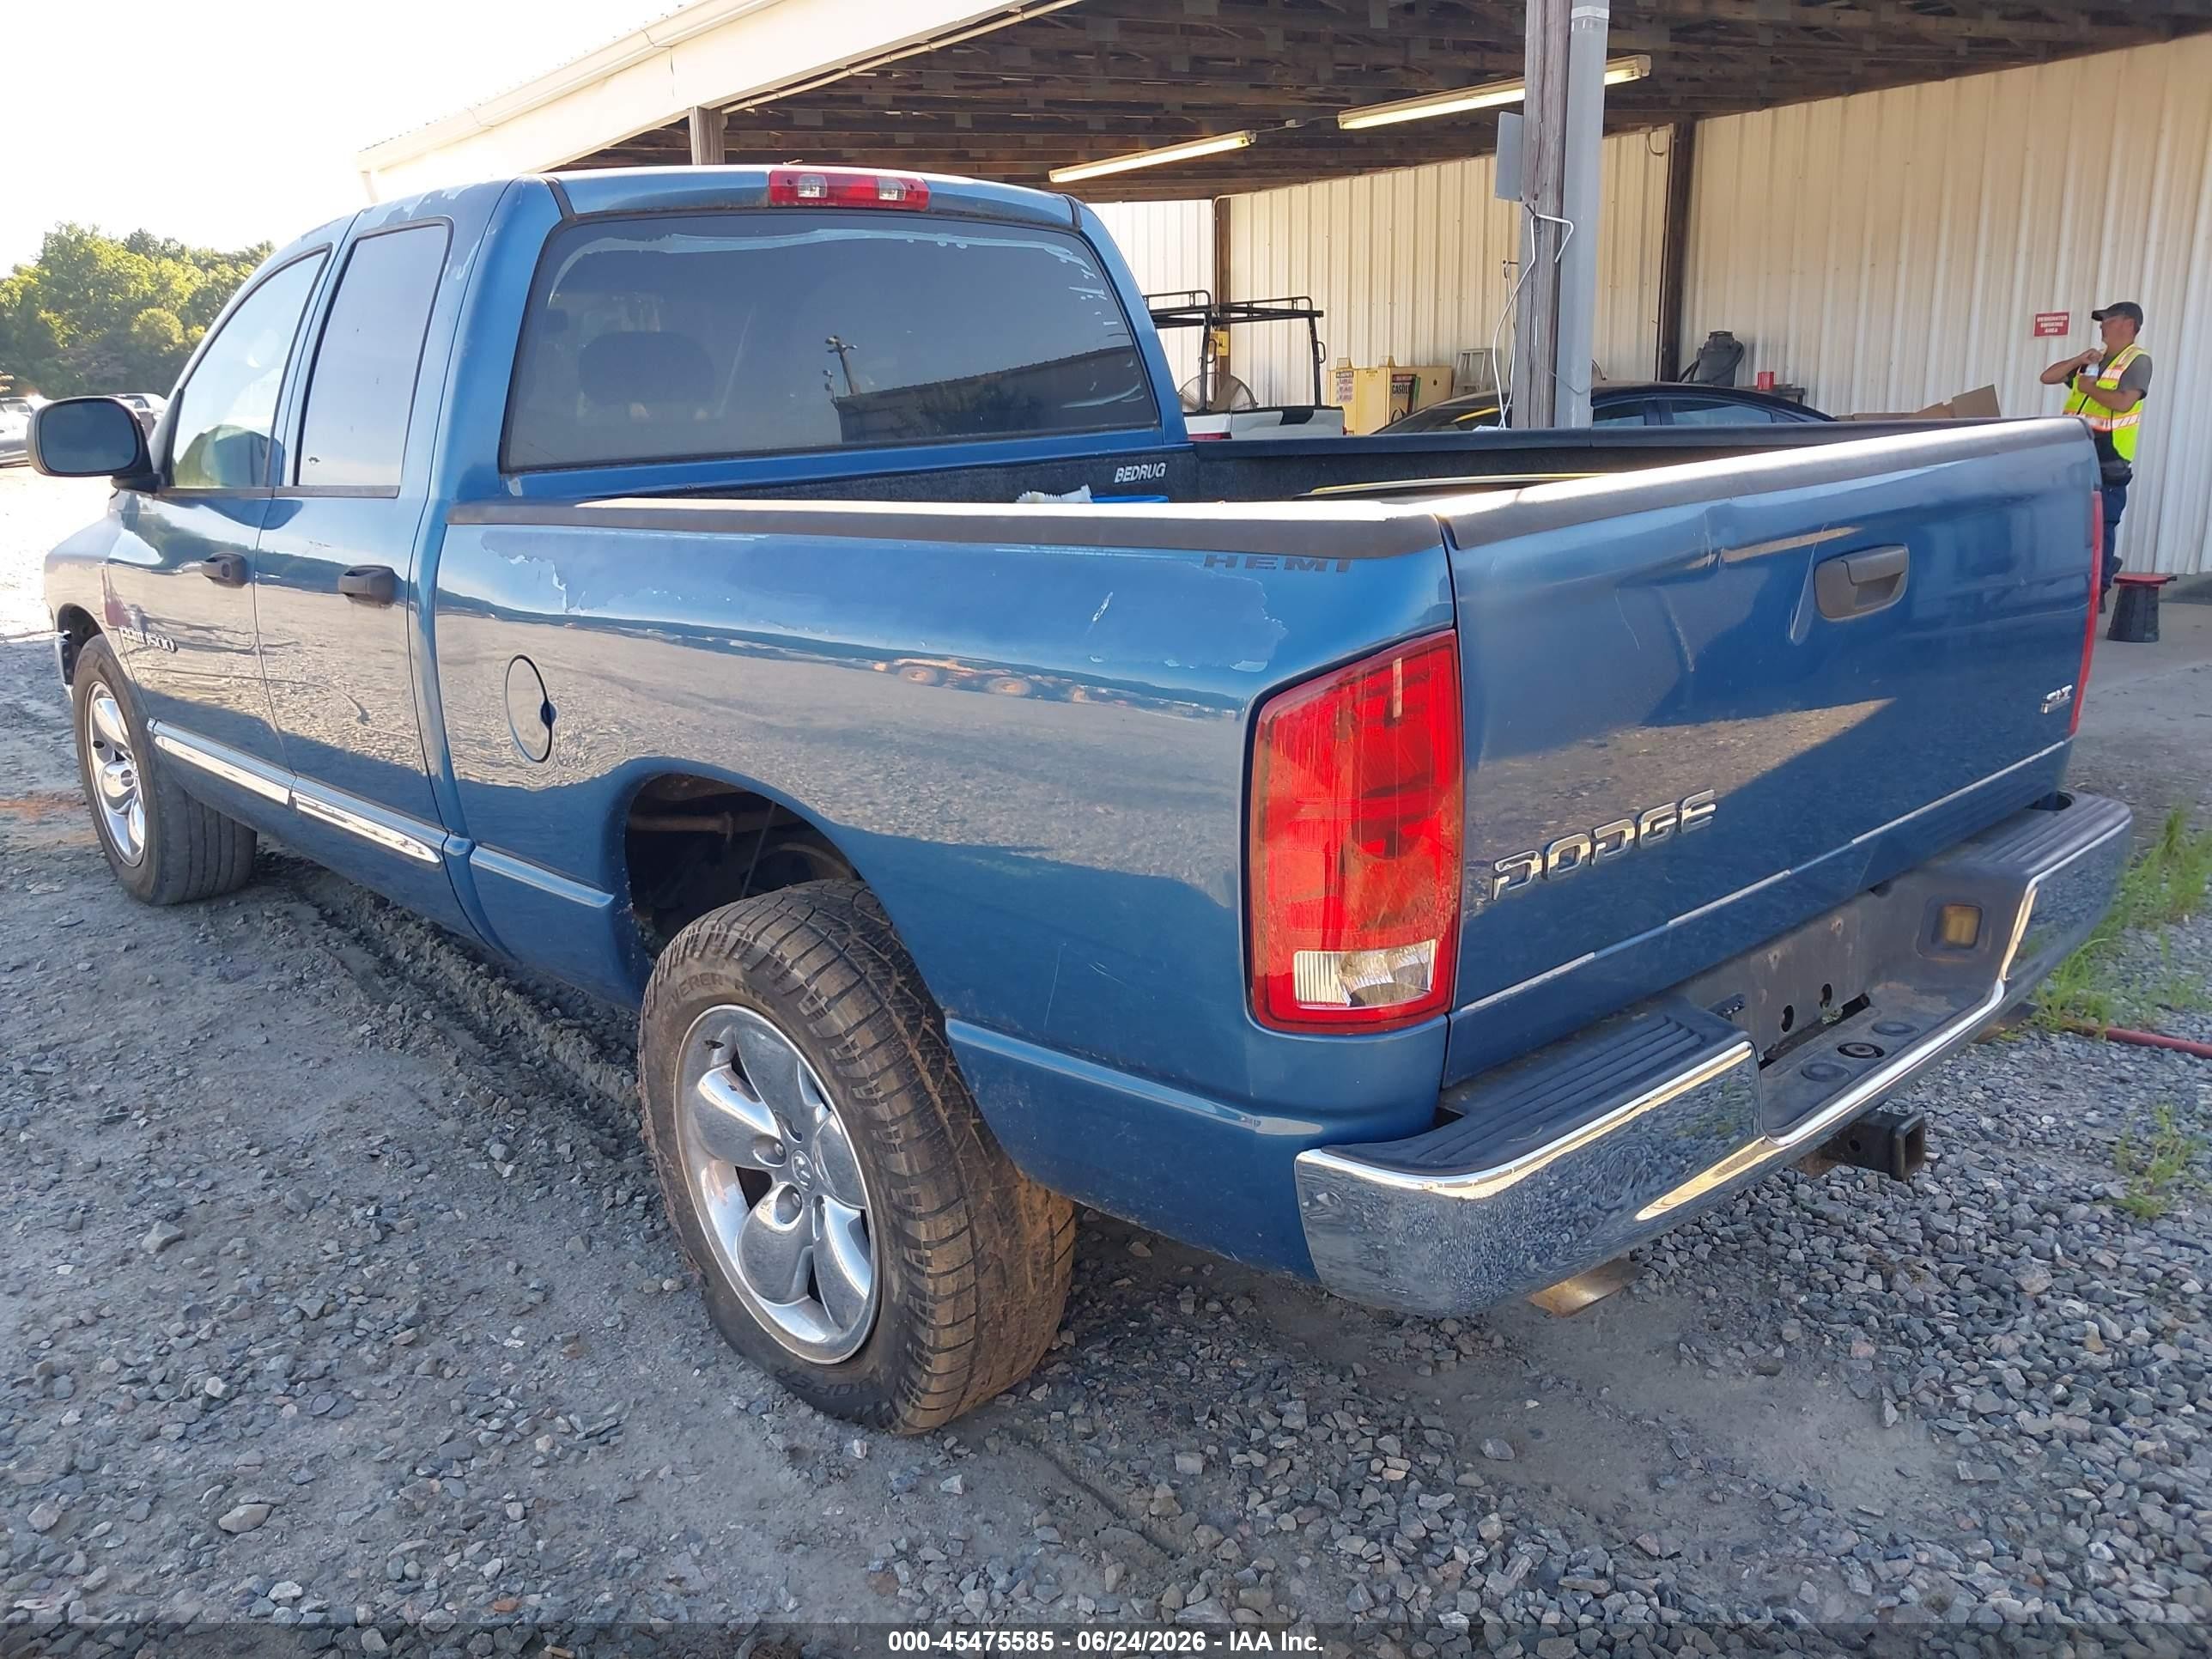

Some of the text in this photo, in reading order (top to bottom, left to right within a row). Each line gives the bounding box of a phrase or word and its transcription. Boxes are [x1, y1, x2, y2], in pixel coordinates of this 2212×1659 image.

[1114, 462, 1167, 483] BEDRUG
[1204, 554, 1353, 573] HEMI
[145, 631, 177, 653] 1500
[1492, 788, 1717, 902] DODGE
